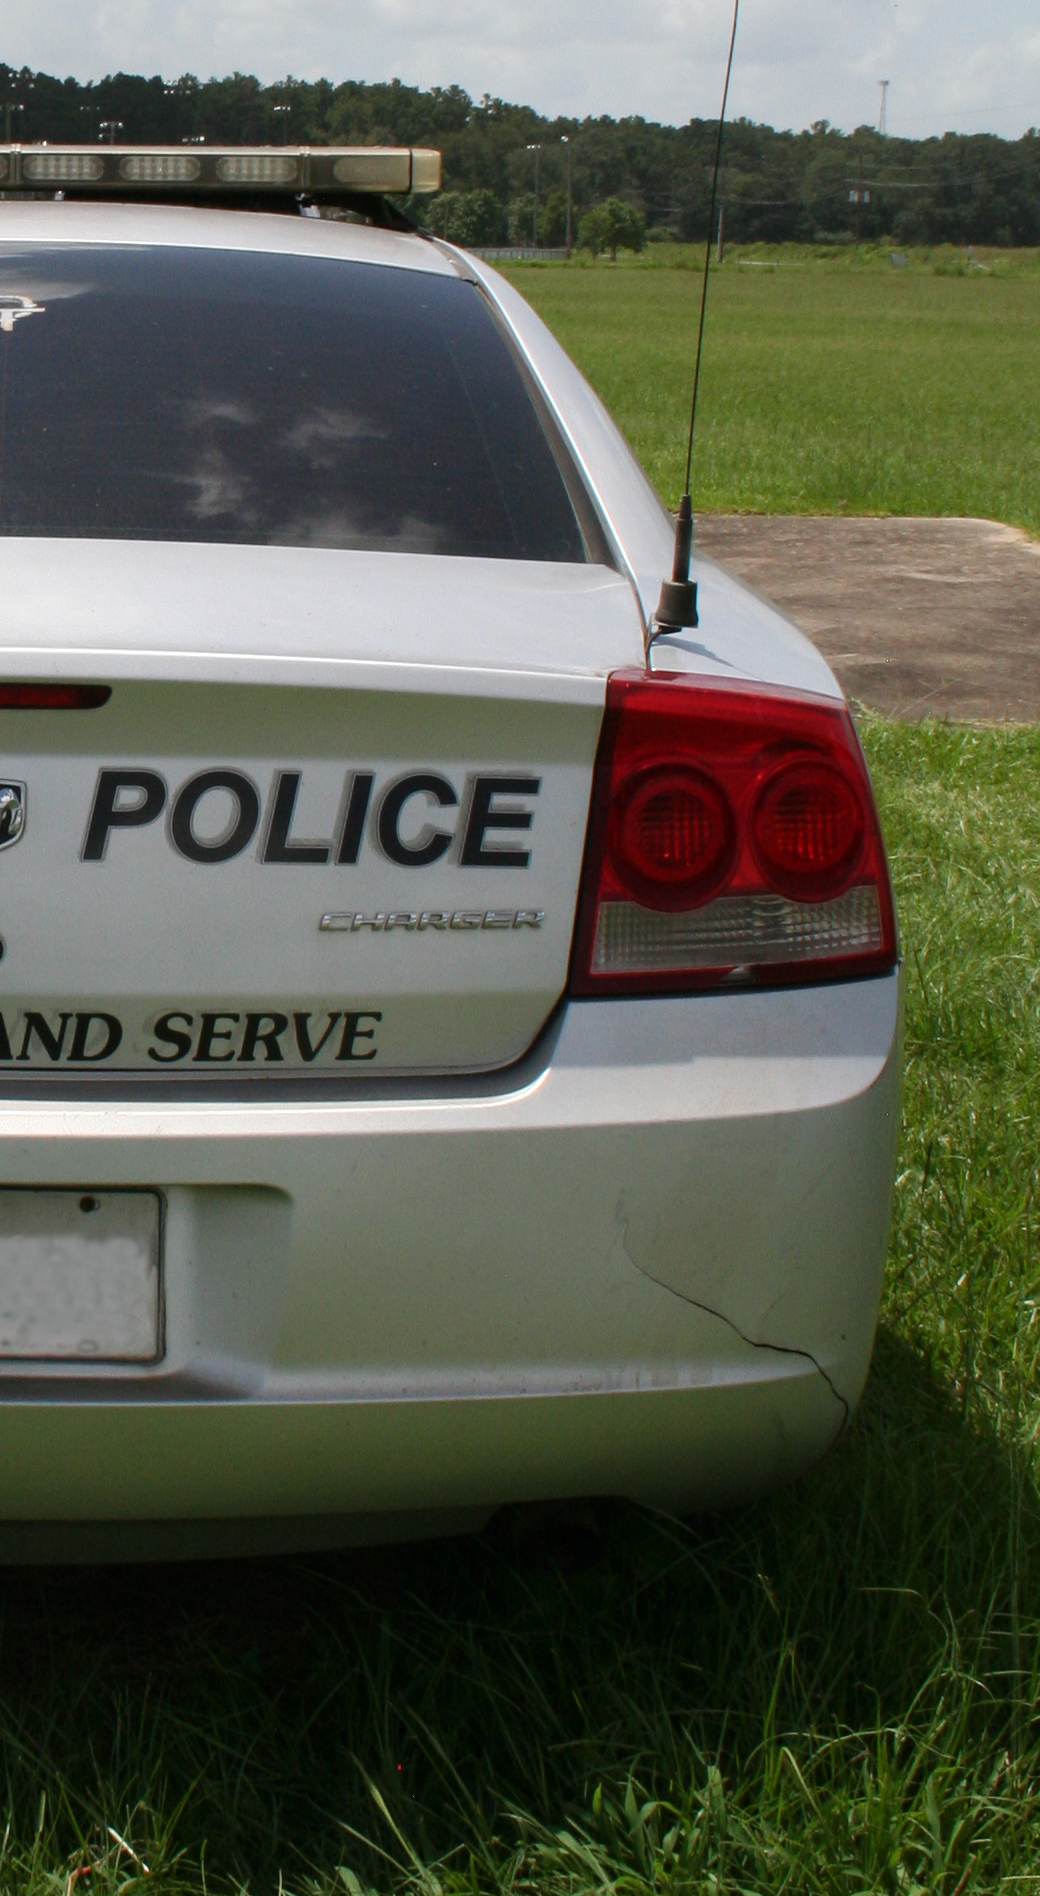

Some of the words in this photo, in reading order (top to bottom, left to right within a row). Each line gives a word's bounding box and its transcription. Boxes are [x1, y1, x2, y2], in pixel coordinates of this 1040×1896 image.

[82, 767, 542, 867] POLICE
[318, 909, 545, 932] CHARGER
[147, 1011, 383, 1064] SERVE
